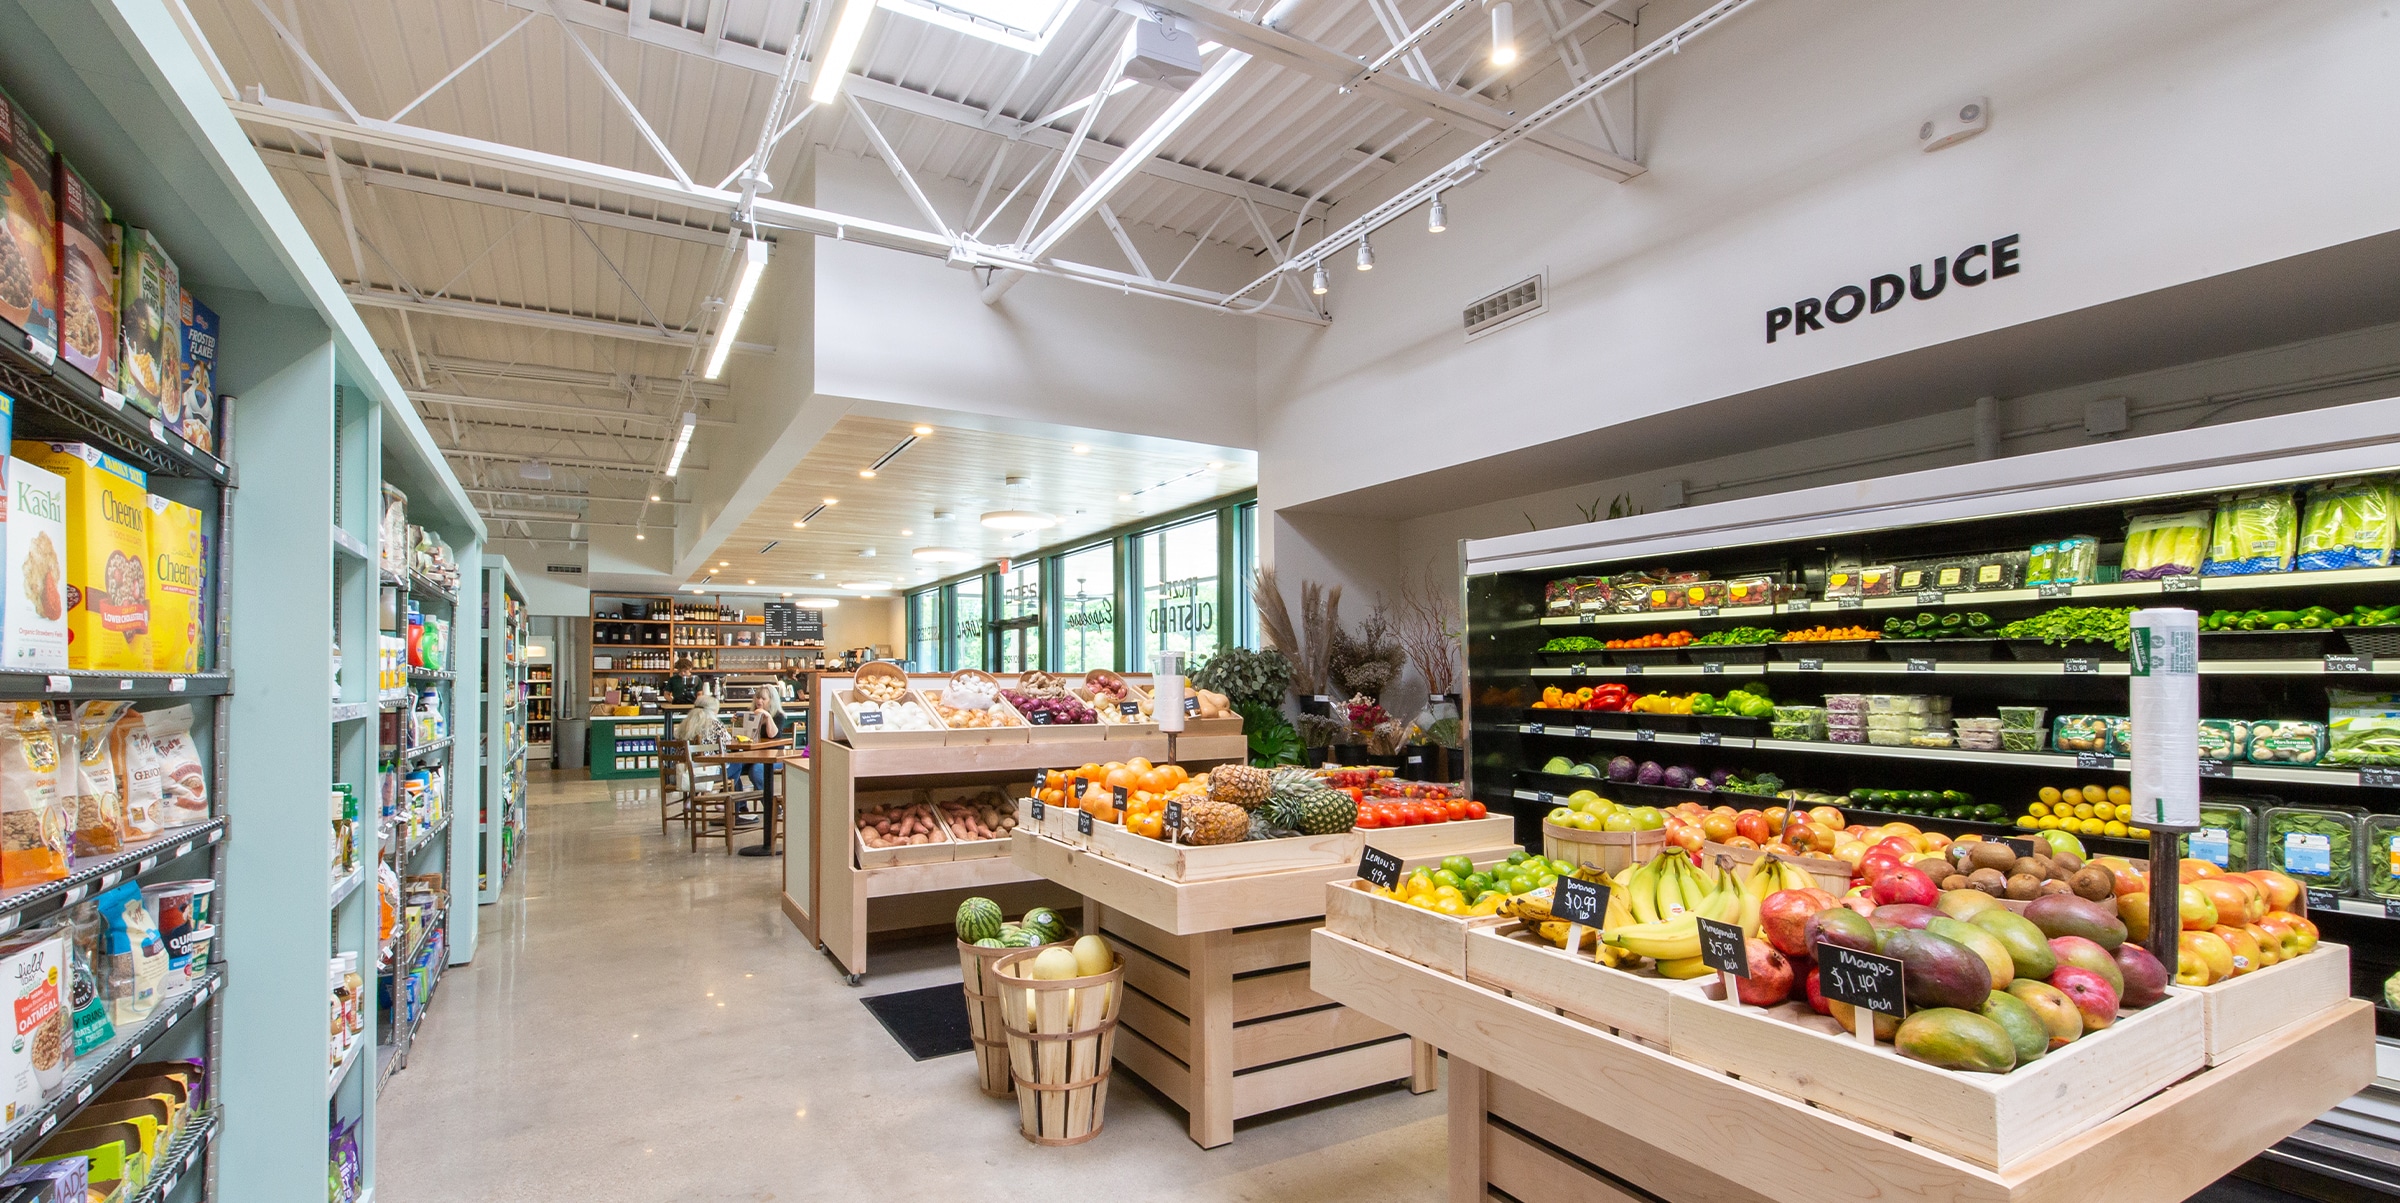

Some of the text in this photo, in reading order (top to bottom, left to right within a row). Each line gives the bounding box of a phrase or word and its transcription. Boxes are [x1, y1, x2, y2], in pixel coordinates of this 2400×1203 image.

[1766, 233, 2020, 343] PRODUCE
[188, 328, 216, 348] FROSTED
[190, 341, 214, 359] FLAKES
[103, 456, 129, 478] FAMILY
[17, 480, 62, 523] Kashi
[102, 489, 143, 532] Cheerios
[104, 612, 121, 623] LOWER
[18, 627, 35, 636] Organic
[2134, 629, 2148, 664] OPEN HERE
[1564, 891, 1597, 914] $0.99
[1708, 937, 1735, 957] $5.99
[15, 951, 44, 979] field
[1723, 957, 1739, 970] each
[1839, 950, 1894, 977] Mangos
[1830, 966, 1878, 995] $1.49
[19, 998, 58, 1032] OATMEAL
[1868, 997, 1892, 1010] each
